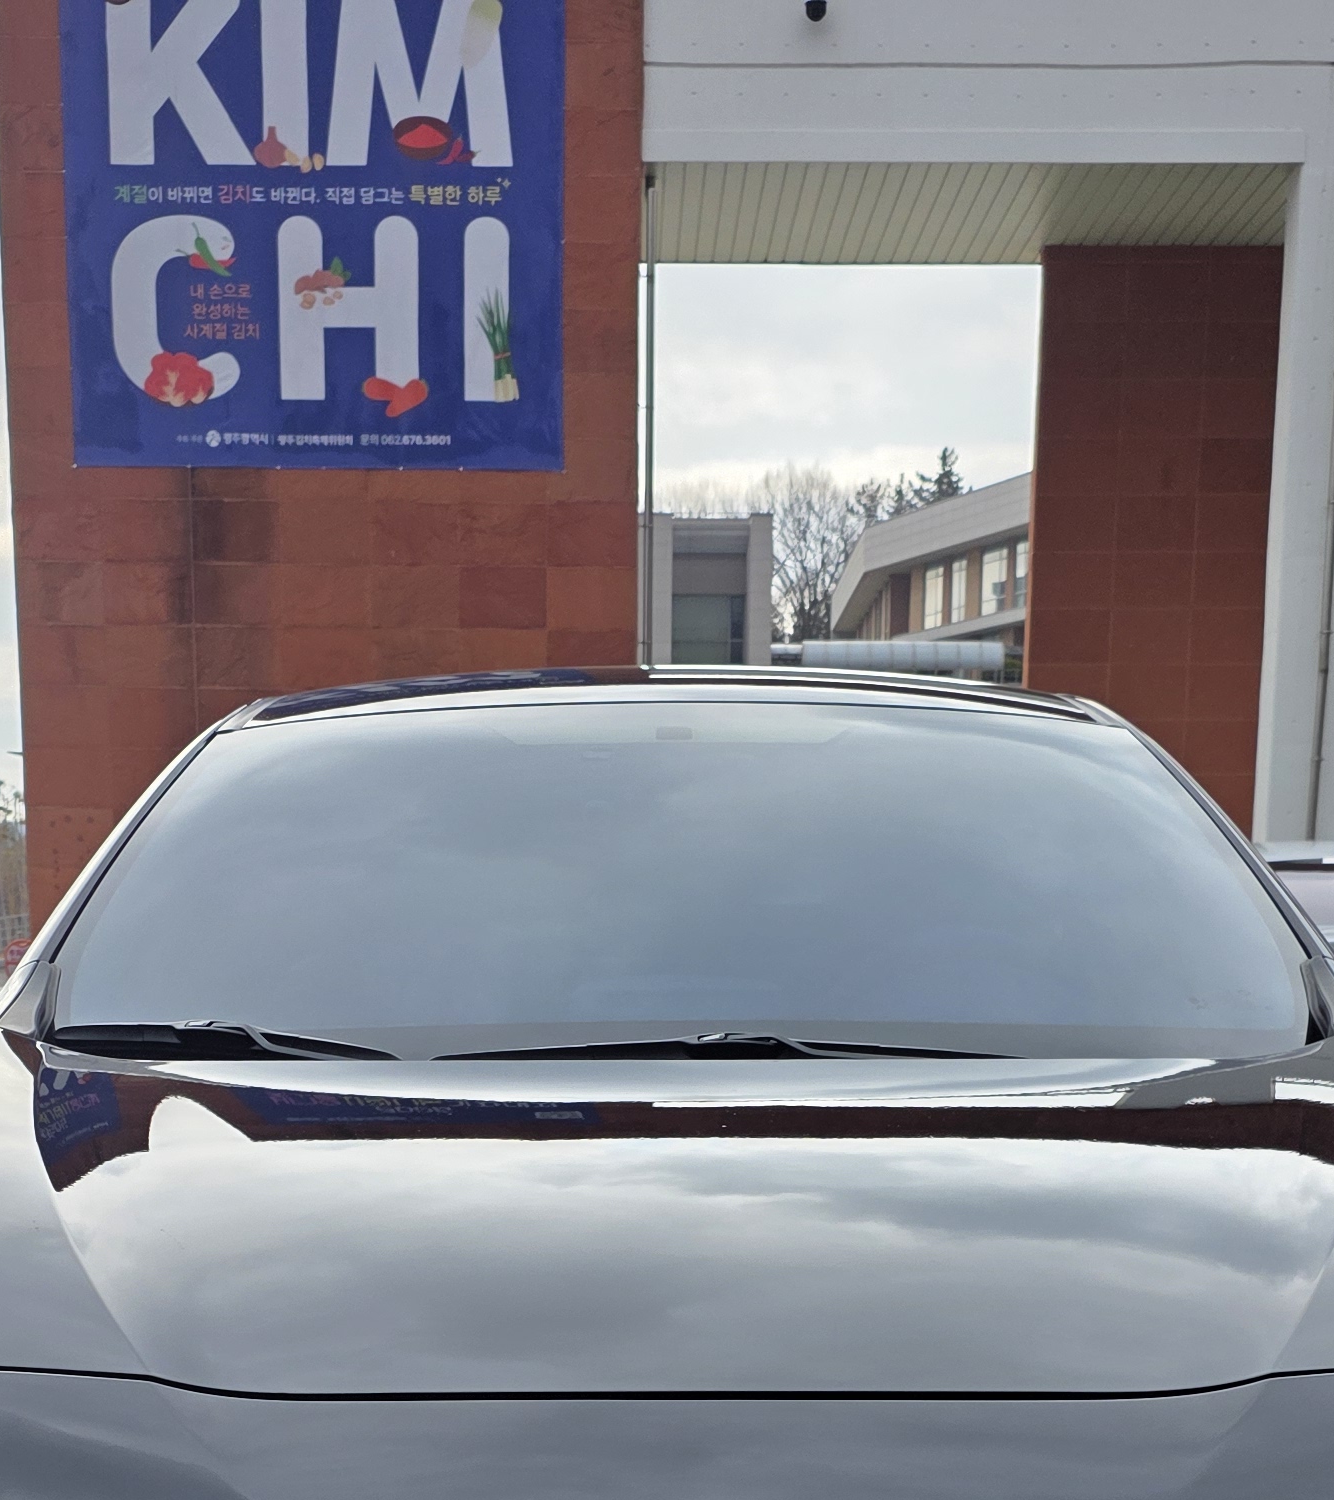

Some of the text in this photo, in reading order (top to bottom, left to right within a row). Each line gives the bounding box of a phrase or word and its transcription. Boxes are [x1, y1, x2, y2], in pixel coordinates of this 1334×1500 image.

[106, 0, 513, 167] KIM
[114, 184, 502, 206] 계절이 바뀌면 김치도 바뀐다. 직접 담그는 특별한 하루
[189, 283, 252, 300] 내 손으로
[111, 214, 513, 403] CHI
[192, 303, 251, 320] 완성하는
[183, 322, 260, 340] 사계절 김치
